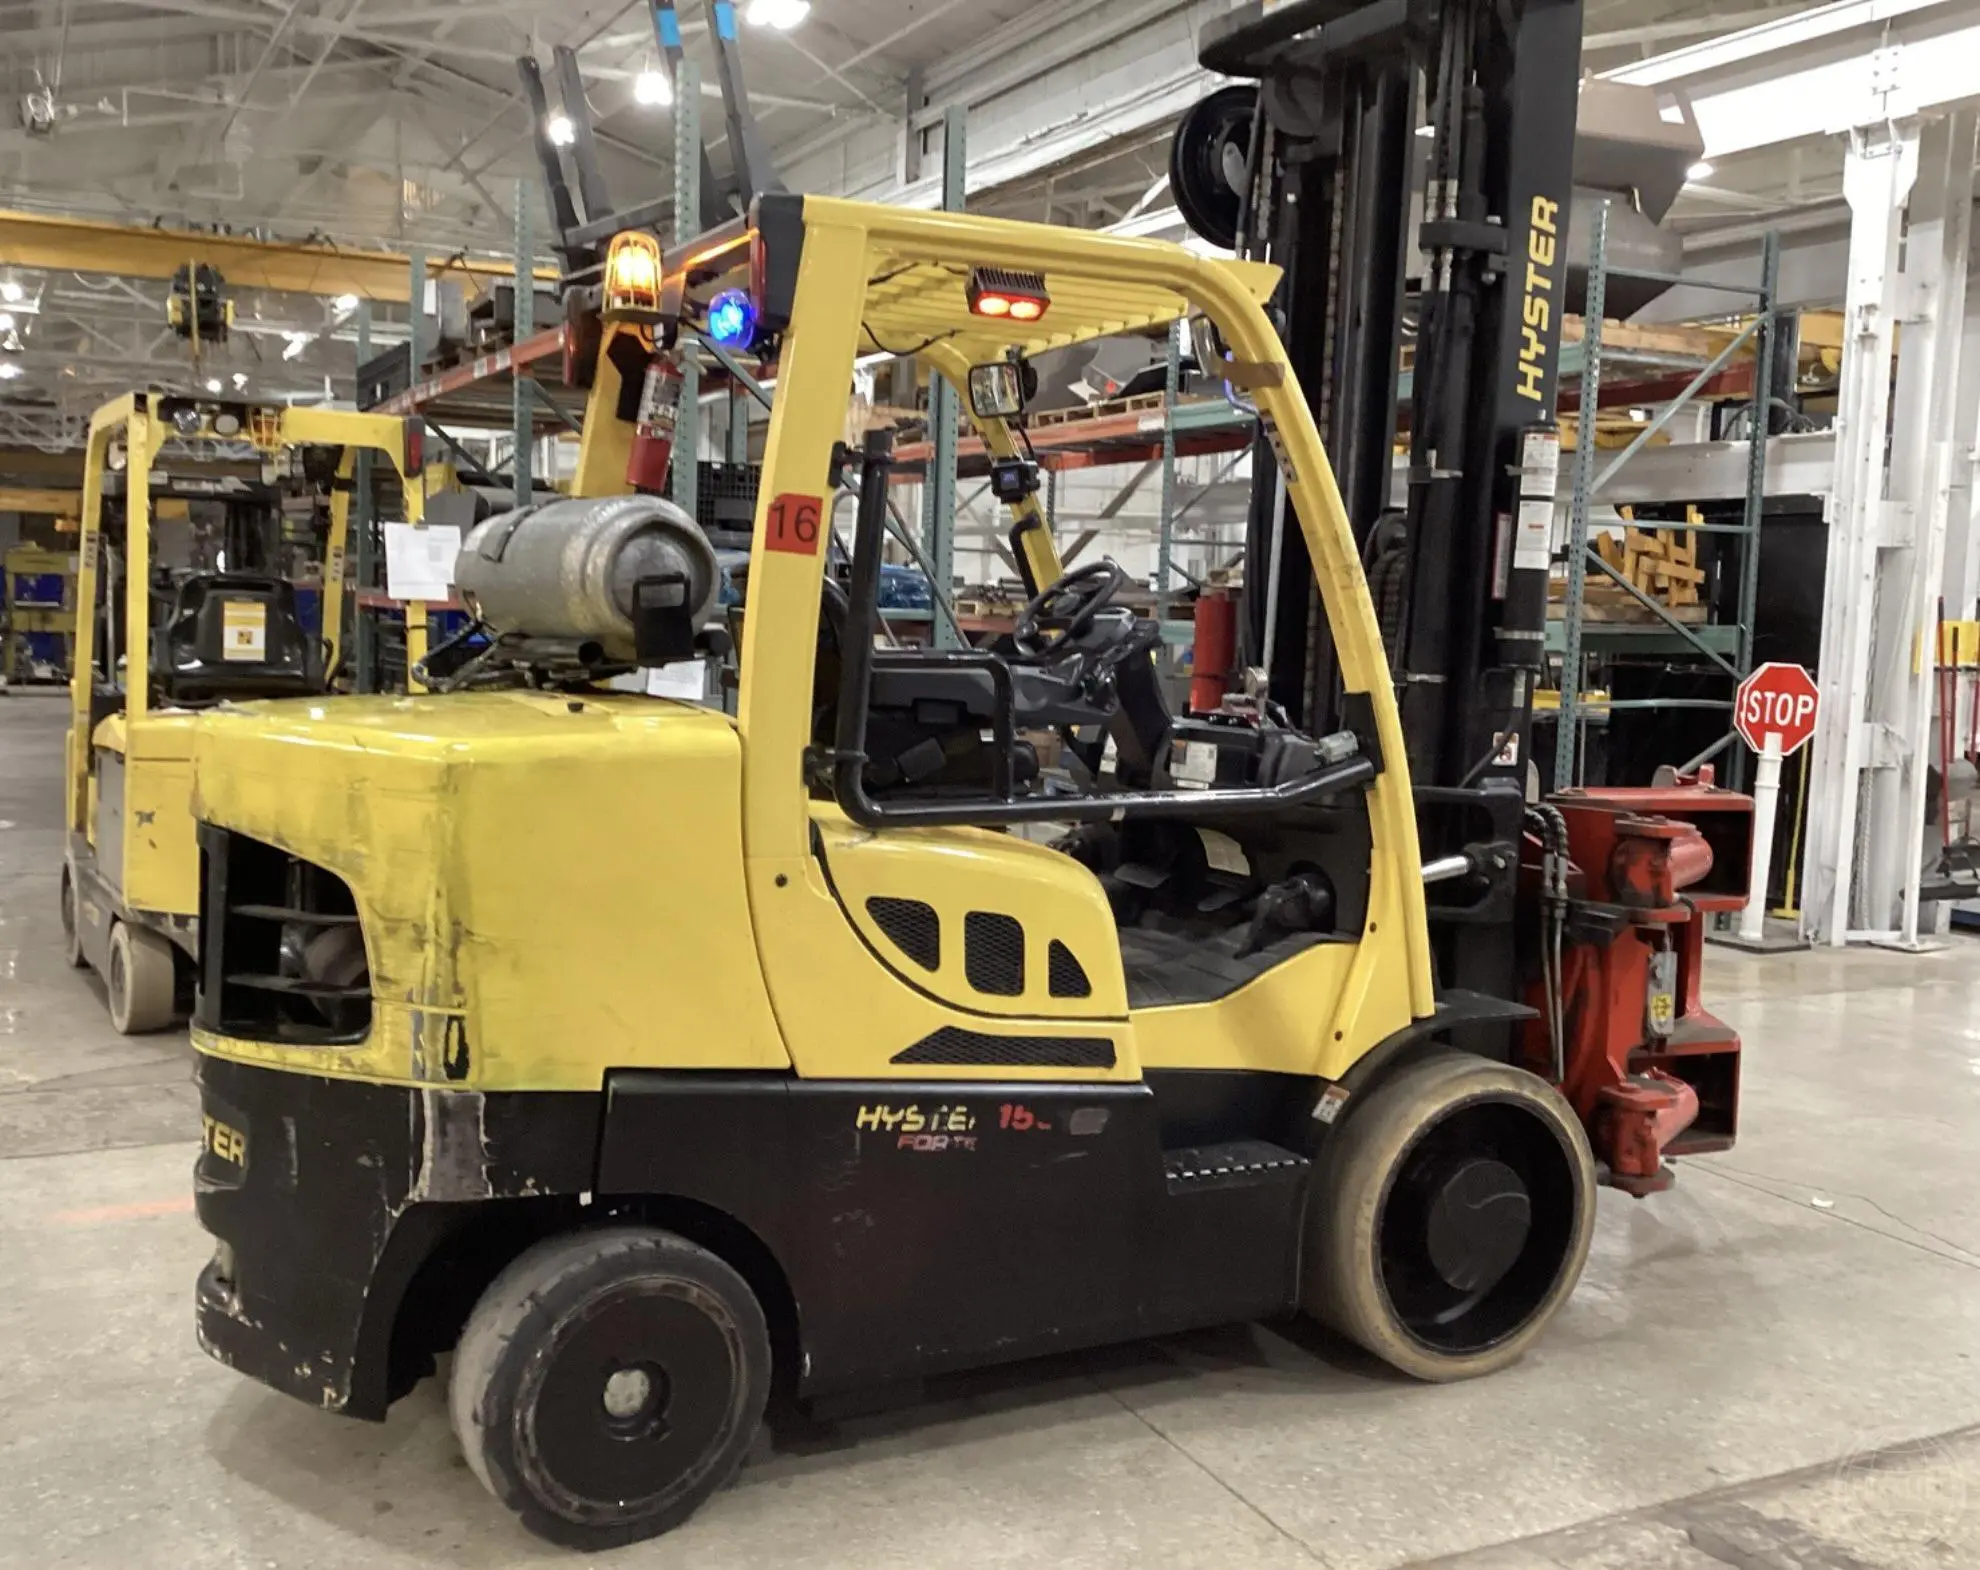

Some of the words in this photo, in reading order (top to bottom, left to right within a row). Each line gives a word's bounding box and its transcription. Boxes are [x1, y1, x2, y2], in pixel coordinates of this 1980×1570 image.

[1517, 195, 1558, 401] HYSTER
[771, 503, 817, 543] 16
[1747, 690, 1815, 727] STOP
[1000, 1103, 1052, 1131] 15
[203, 1111, 246, 1168] TER
